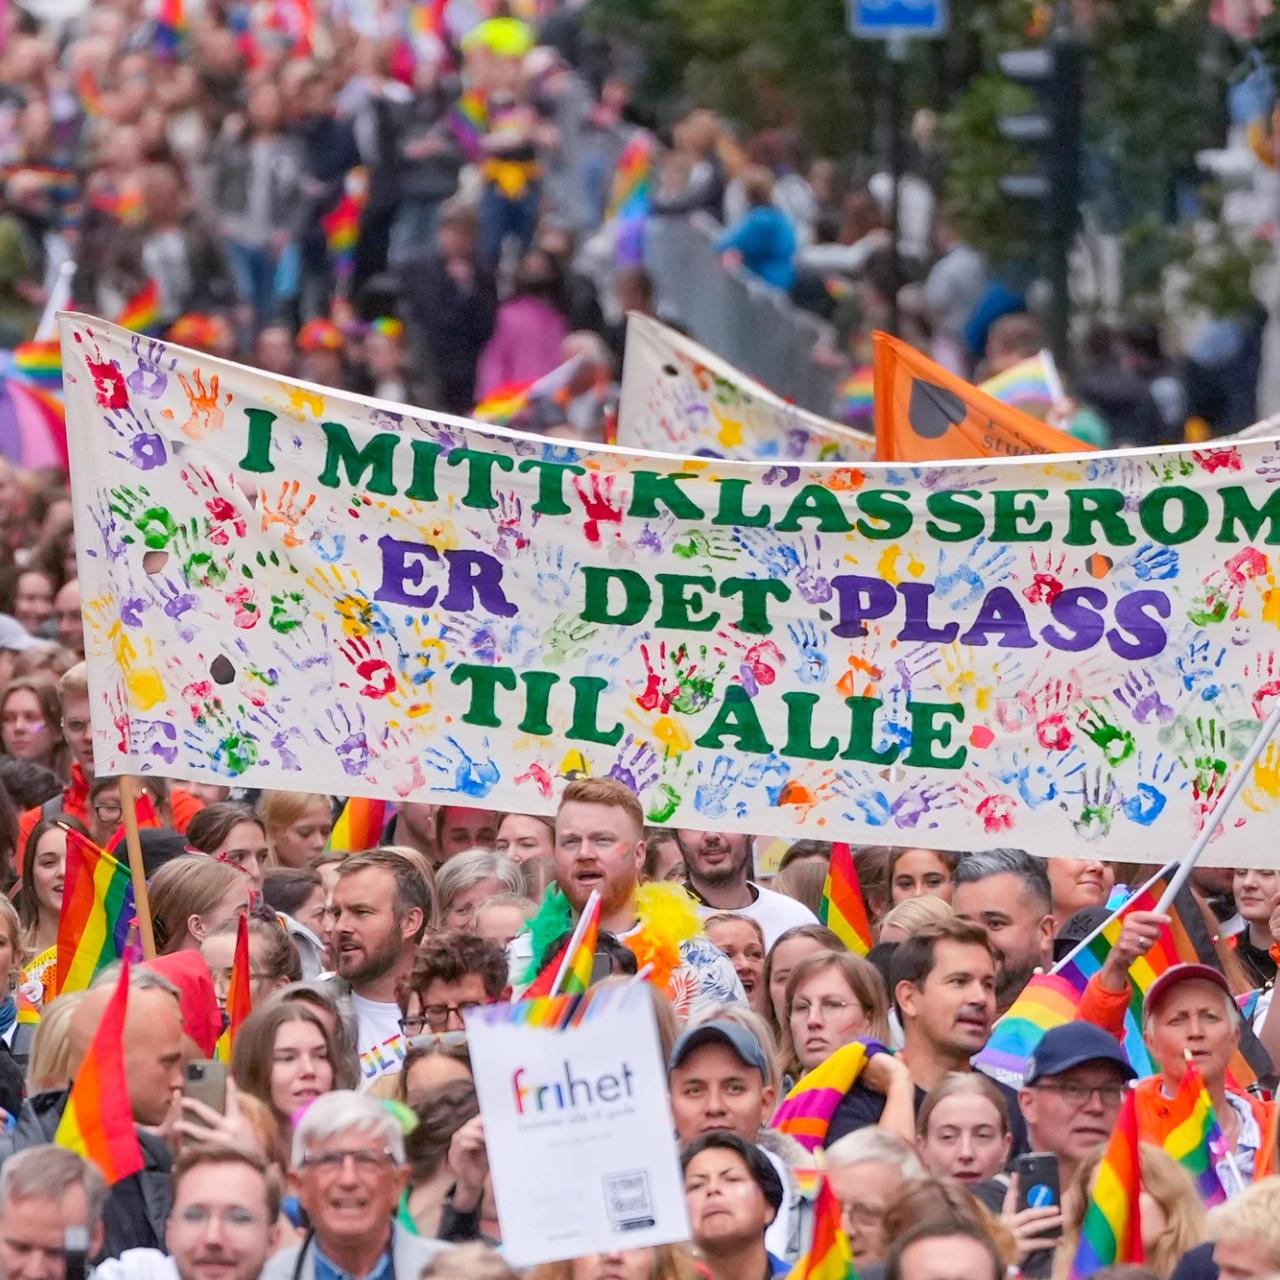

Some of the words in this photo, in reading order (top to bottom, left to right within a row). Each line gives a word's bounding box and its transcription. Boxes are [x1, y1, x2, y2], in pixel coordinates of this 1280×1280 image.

[239, 407, 277, 473] I
[319, 422, 586, 516] MITT
[374, 534, 519, 618] ER
[579, 565, 792, 635] DET
[830, 573, 1172, 662] PLASS
[450, 662, 625, 746] TIL
[695, 684, 968, 770] ALLE
[510, 1058, 636, 1115] frihet
